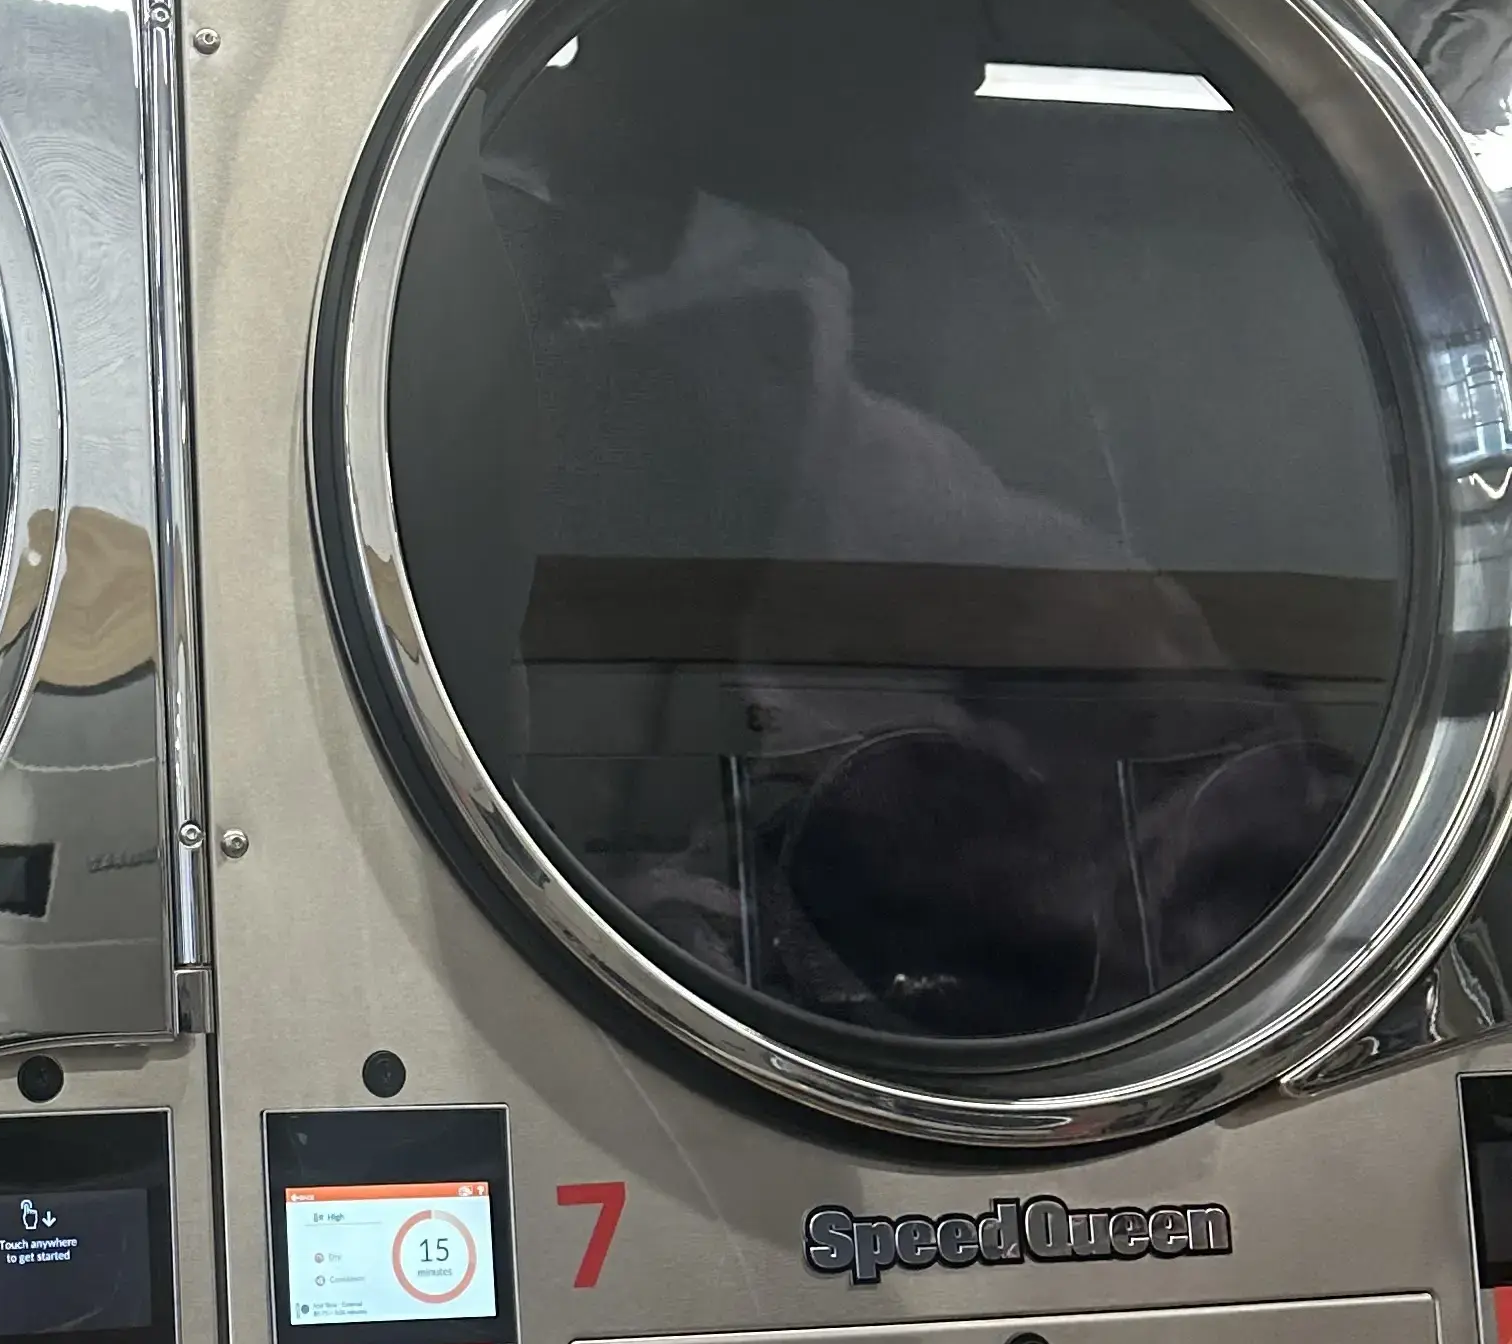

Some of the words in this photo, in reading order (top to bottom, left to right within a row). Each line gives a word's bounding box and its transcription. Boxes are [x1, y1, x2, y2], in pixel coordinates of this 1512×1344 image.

[327, 1213, 345, 1223] High
[556, 1181, 625, 1288] 7
[804, 1197, 1023, 1284] Speed
[1023, 1194, 1232, 1261] Queen
[30, 1237, 78, 1249] anywhere
[6, 1253, 17, 1264] to
[19, 1253, 35, 1264] get
[37, 1250, 71, 1262] started
[419, 1238, 449, 1263] 15
[417, 1267, 453, 1277] minutes
